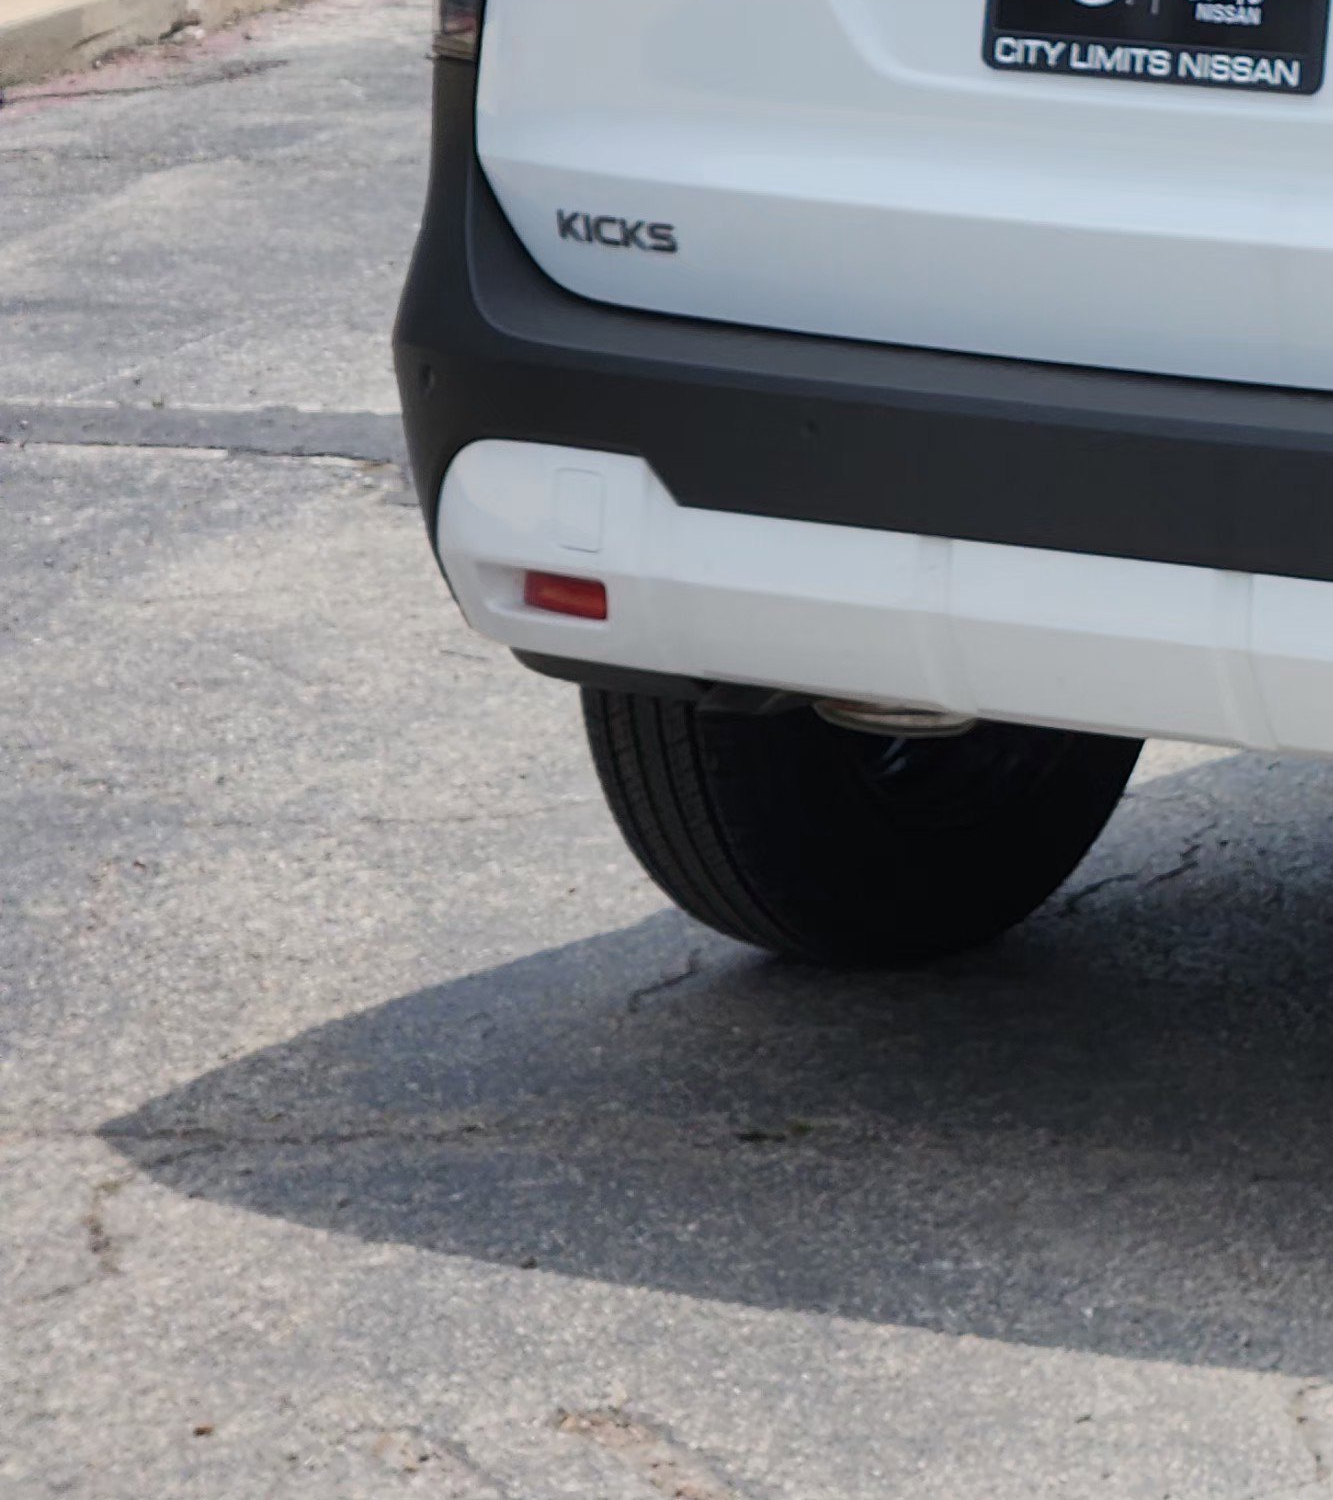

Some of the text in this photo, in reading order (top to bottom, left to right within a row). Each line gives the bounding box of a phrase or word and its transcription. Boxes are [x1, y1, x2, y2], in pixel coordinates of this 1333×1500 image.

[1195, 3, 1262, 25] NISSAN
[994, 37, 1300, 88] CITY LIMITS NISSAN
[556, 208, 678, 252] KICKS
